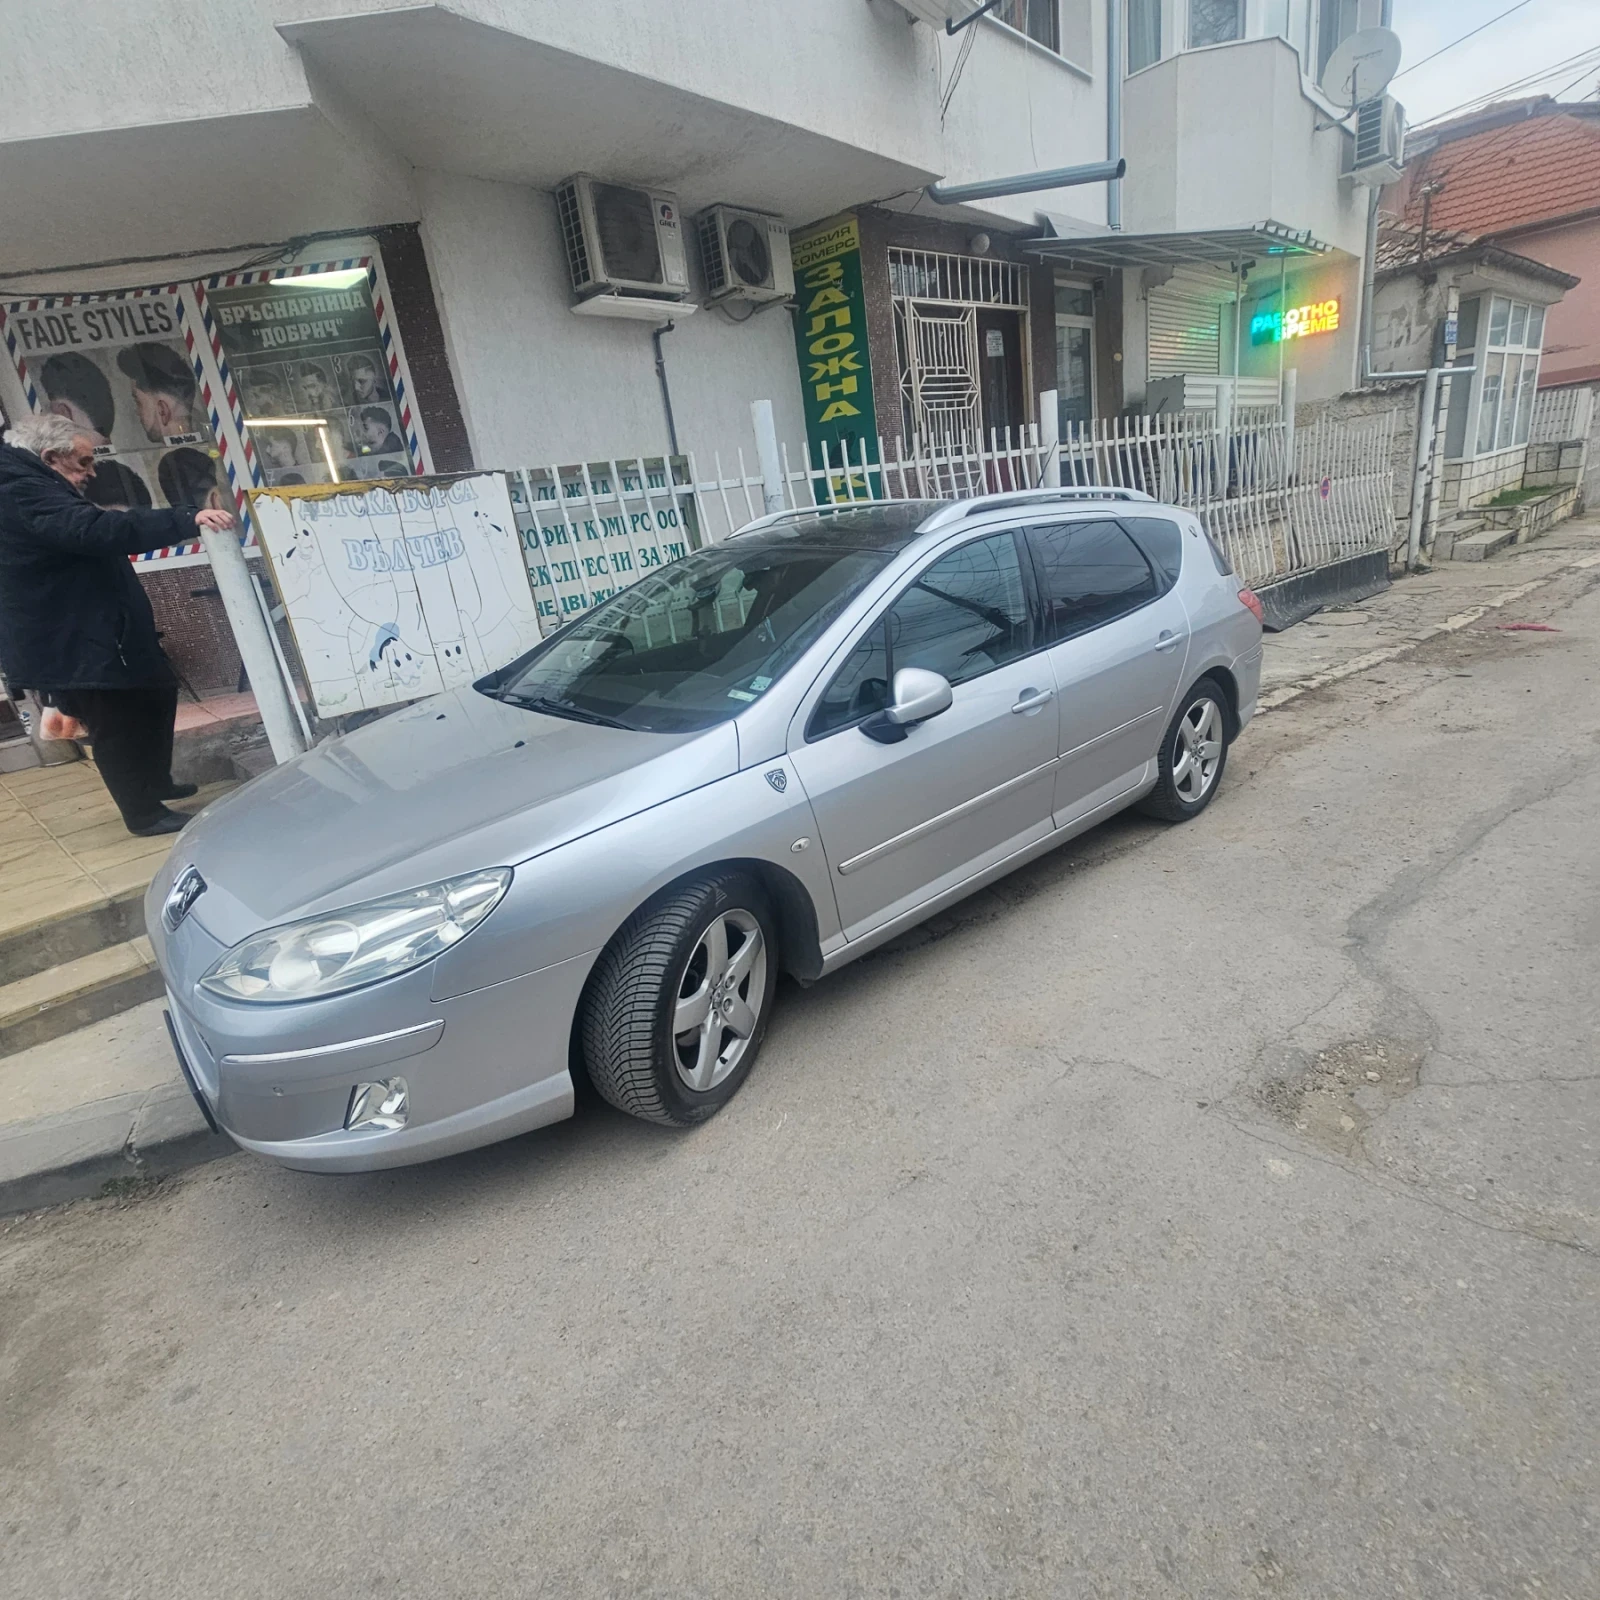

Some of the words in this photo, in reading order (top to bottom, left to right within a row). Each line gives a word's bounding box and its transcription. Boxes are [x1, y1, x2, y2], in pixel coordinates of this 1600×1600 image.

[792, 226, 851, 254] СОФИЯ
[792, 237, 856, 267] КОМЕРС
[217, 290, 367, 326] БРЪСНАРНИЦА
[1251, 299, 1339, 333] РАБОТНО
[16, 312, 83, 350] FADE
[82, 301, 173, 342] STYLES
[251, 317, 344, 348] "ДОБРИЧ"
[804, 261, 864, 423] ЗАЛОЖНА
[1273, 313, 1340, 343] ВРЕМЕ
[333, 356, 343, 374] 3
[341, 527, 466, 572] ВЪЛЧЕВ
[528, 551, 634, 588] ЕКСПЕСНИ
